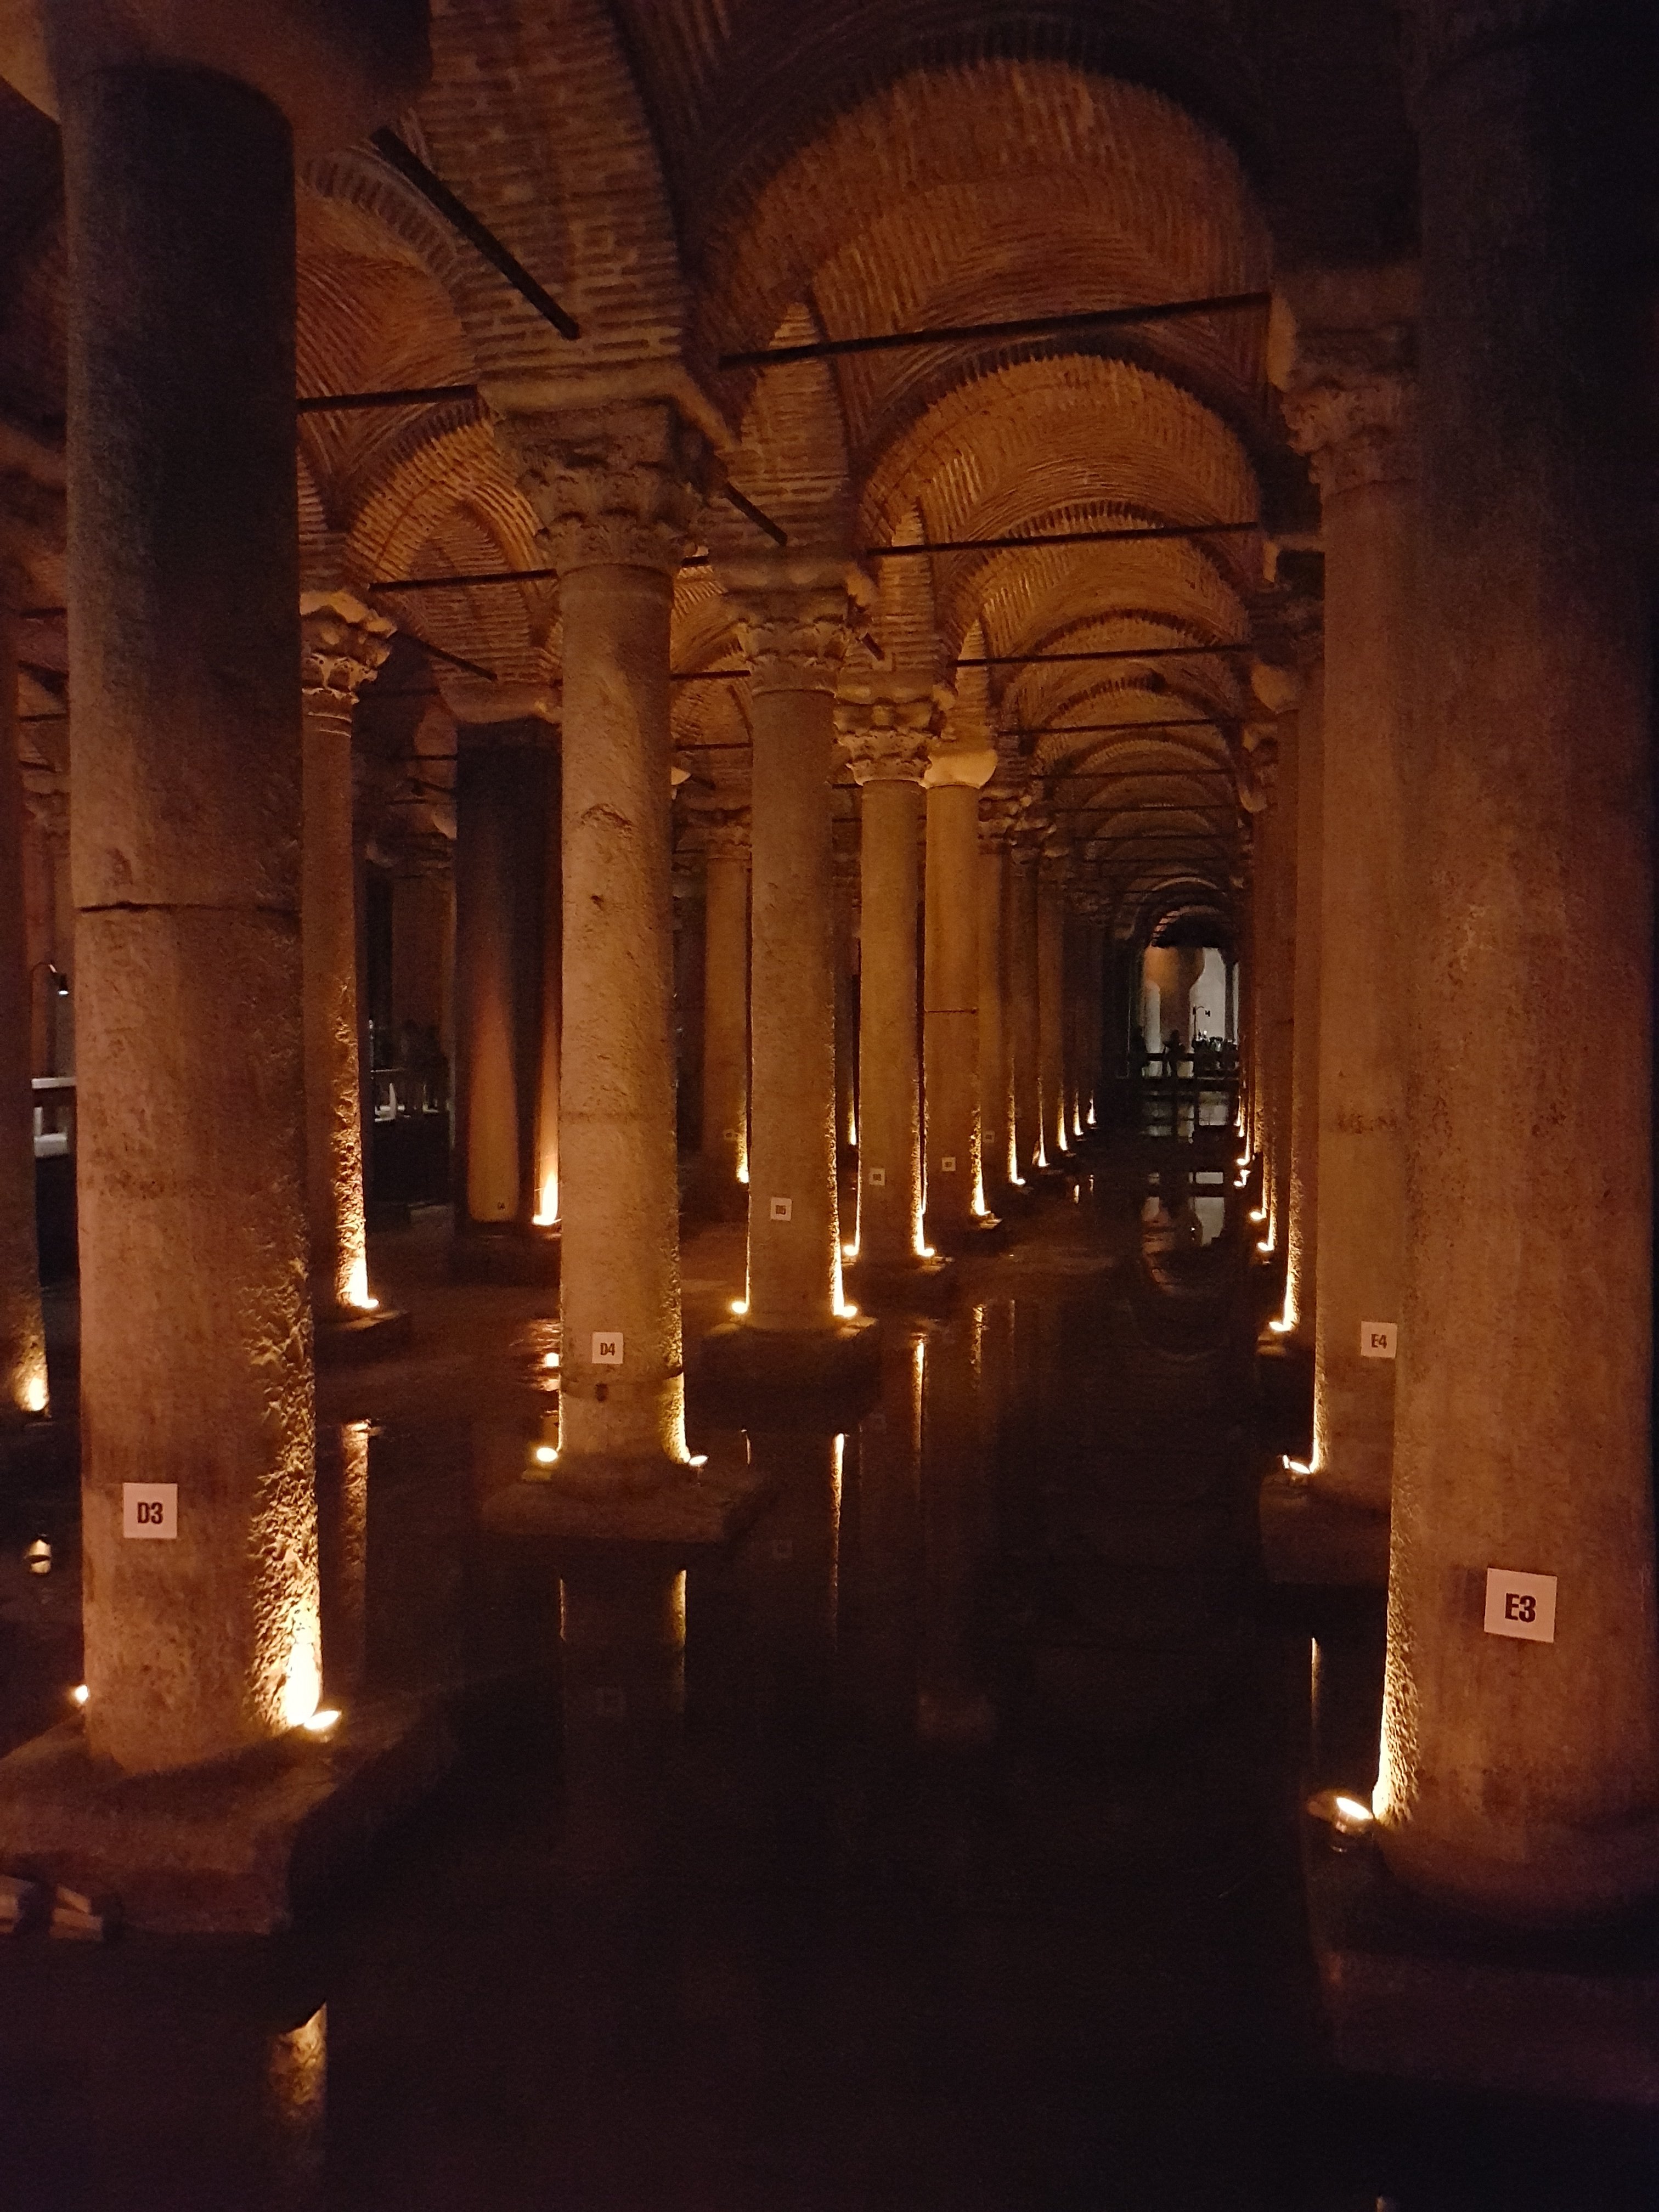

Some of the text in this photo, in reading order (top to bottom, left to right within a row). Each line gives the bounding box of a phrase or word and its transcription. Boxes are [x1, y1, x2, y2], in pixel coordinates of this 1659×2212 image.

[601, 1342, 616, 1356] D4
[1372, 1334, 1387, 1349] E4
[137, 1502, 163, 1524] D3
[1504, 1593, 1536, 1623] E3
